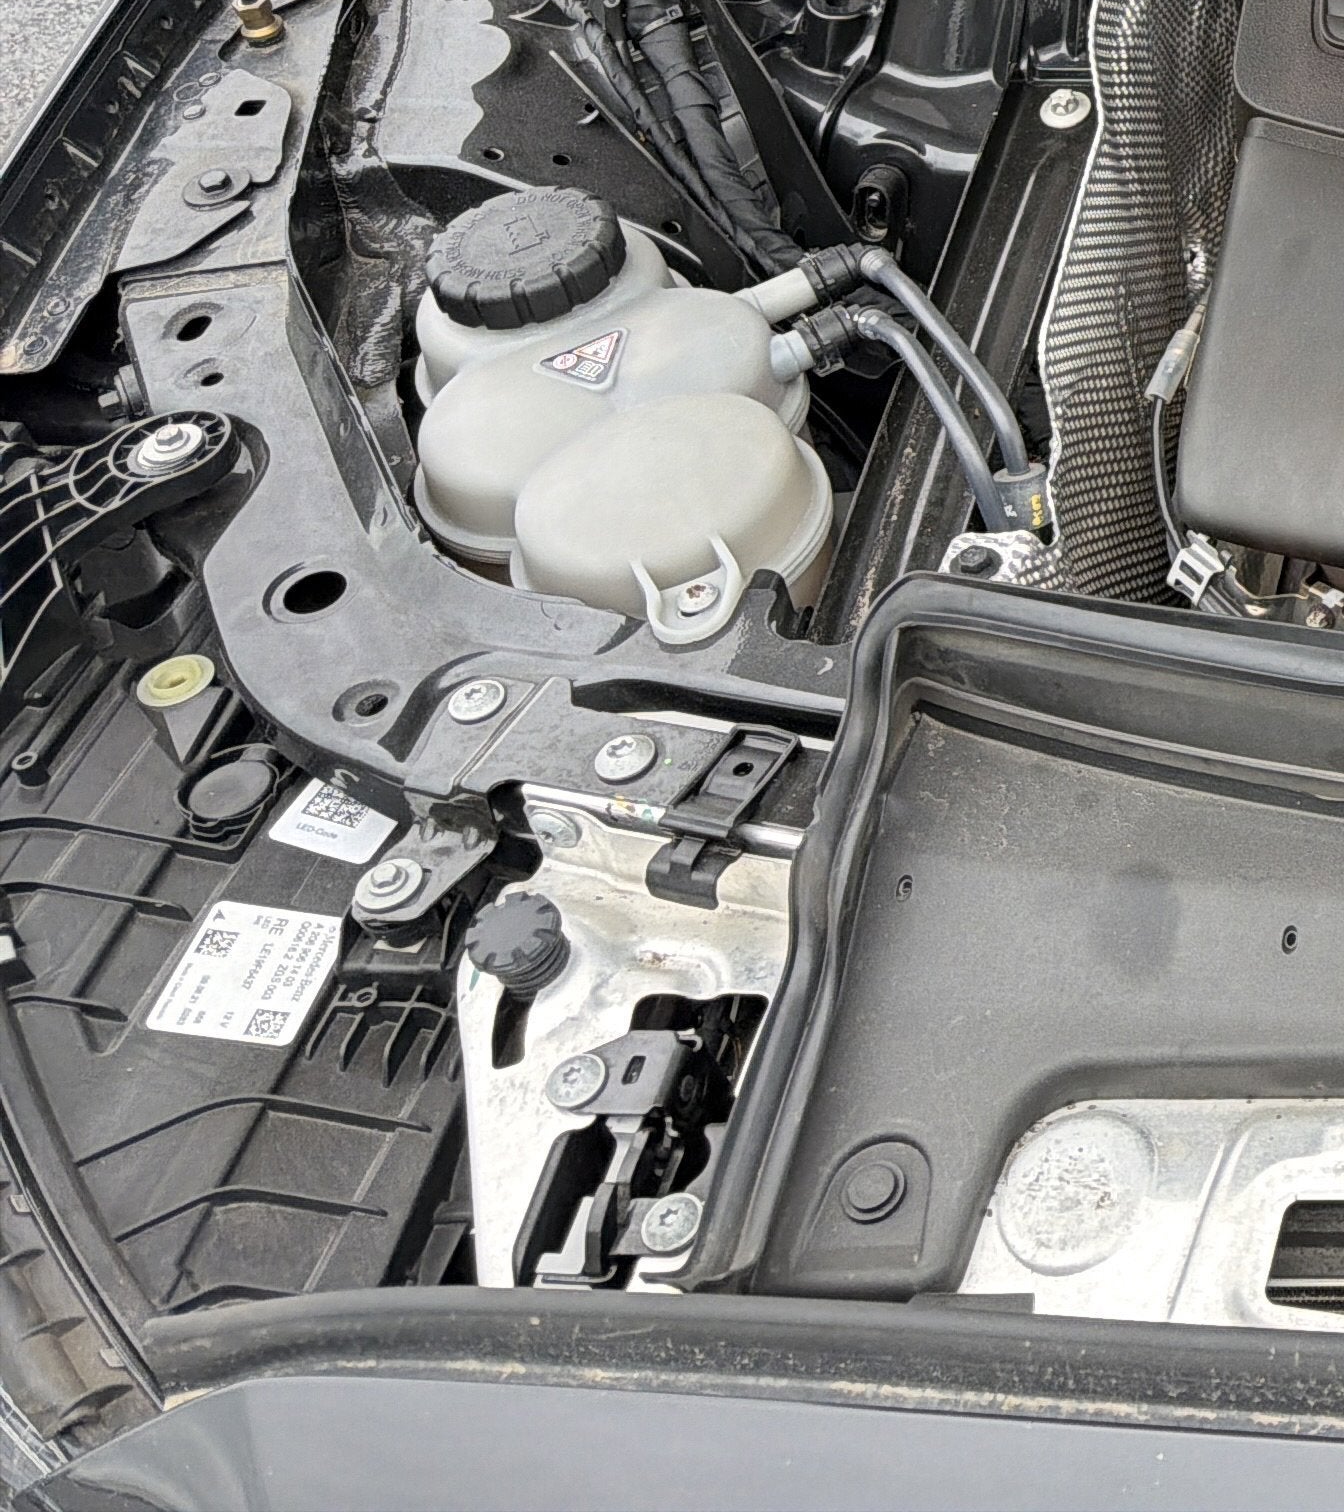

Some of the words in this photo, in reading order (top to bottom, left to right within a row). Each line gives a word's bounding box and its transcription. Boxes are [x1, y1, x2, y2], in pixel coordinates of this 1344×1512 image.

[517, 194, 537, 205] DO
[541, 192, 568, 203] NOT
[484, 267, 526, 280] HEISS
[269, 917, 290, 936] RE
[291, 934, 336, 1002] Mercedes-Benz
